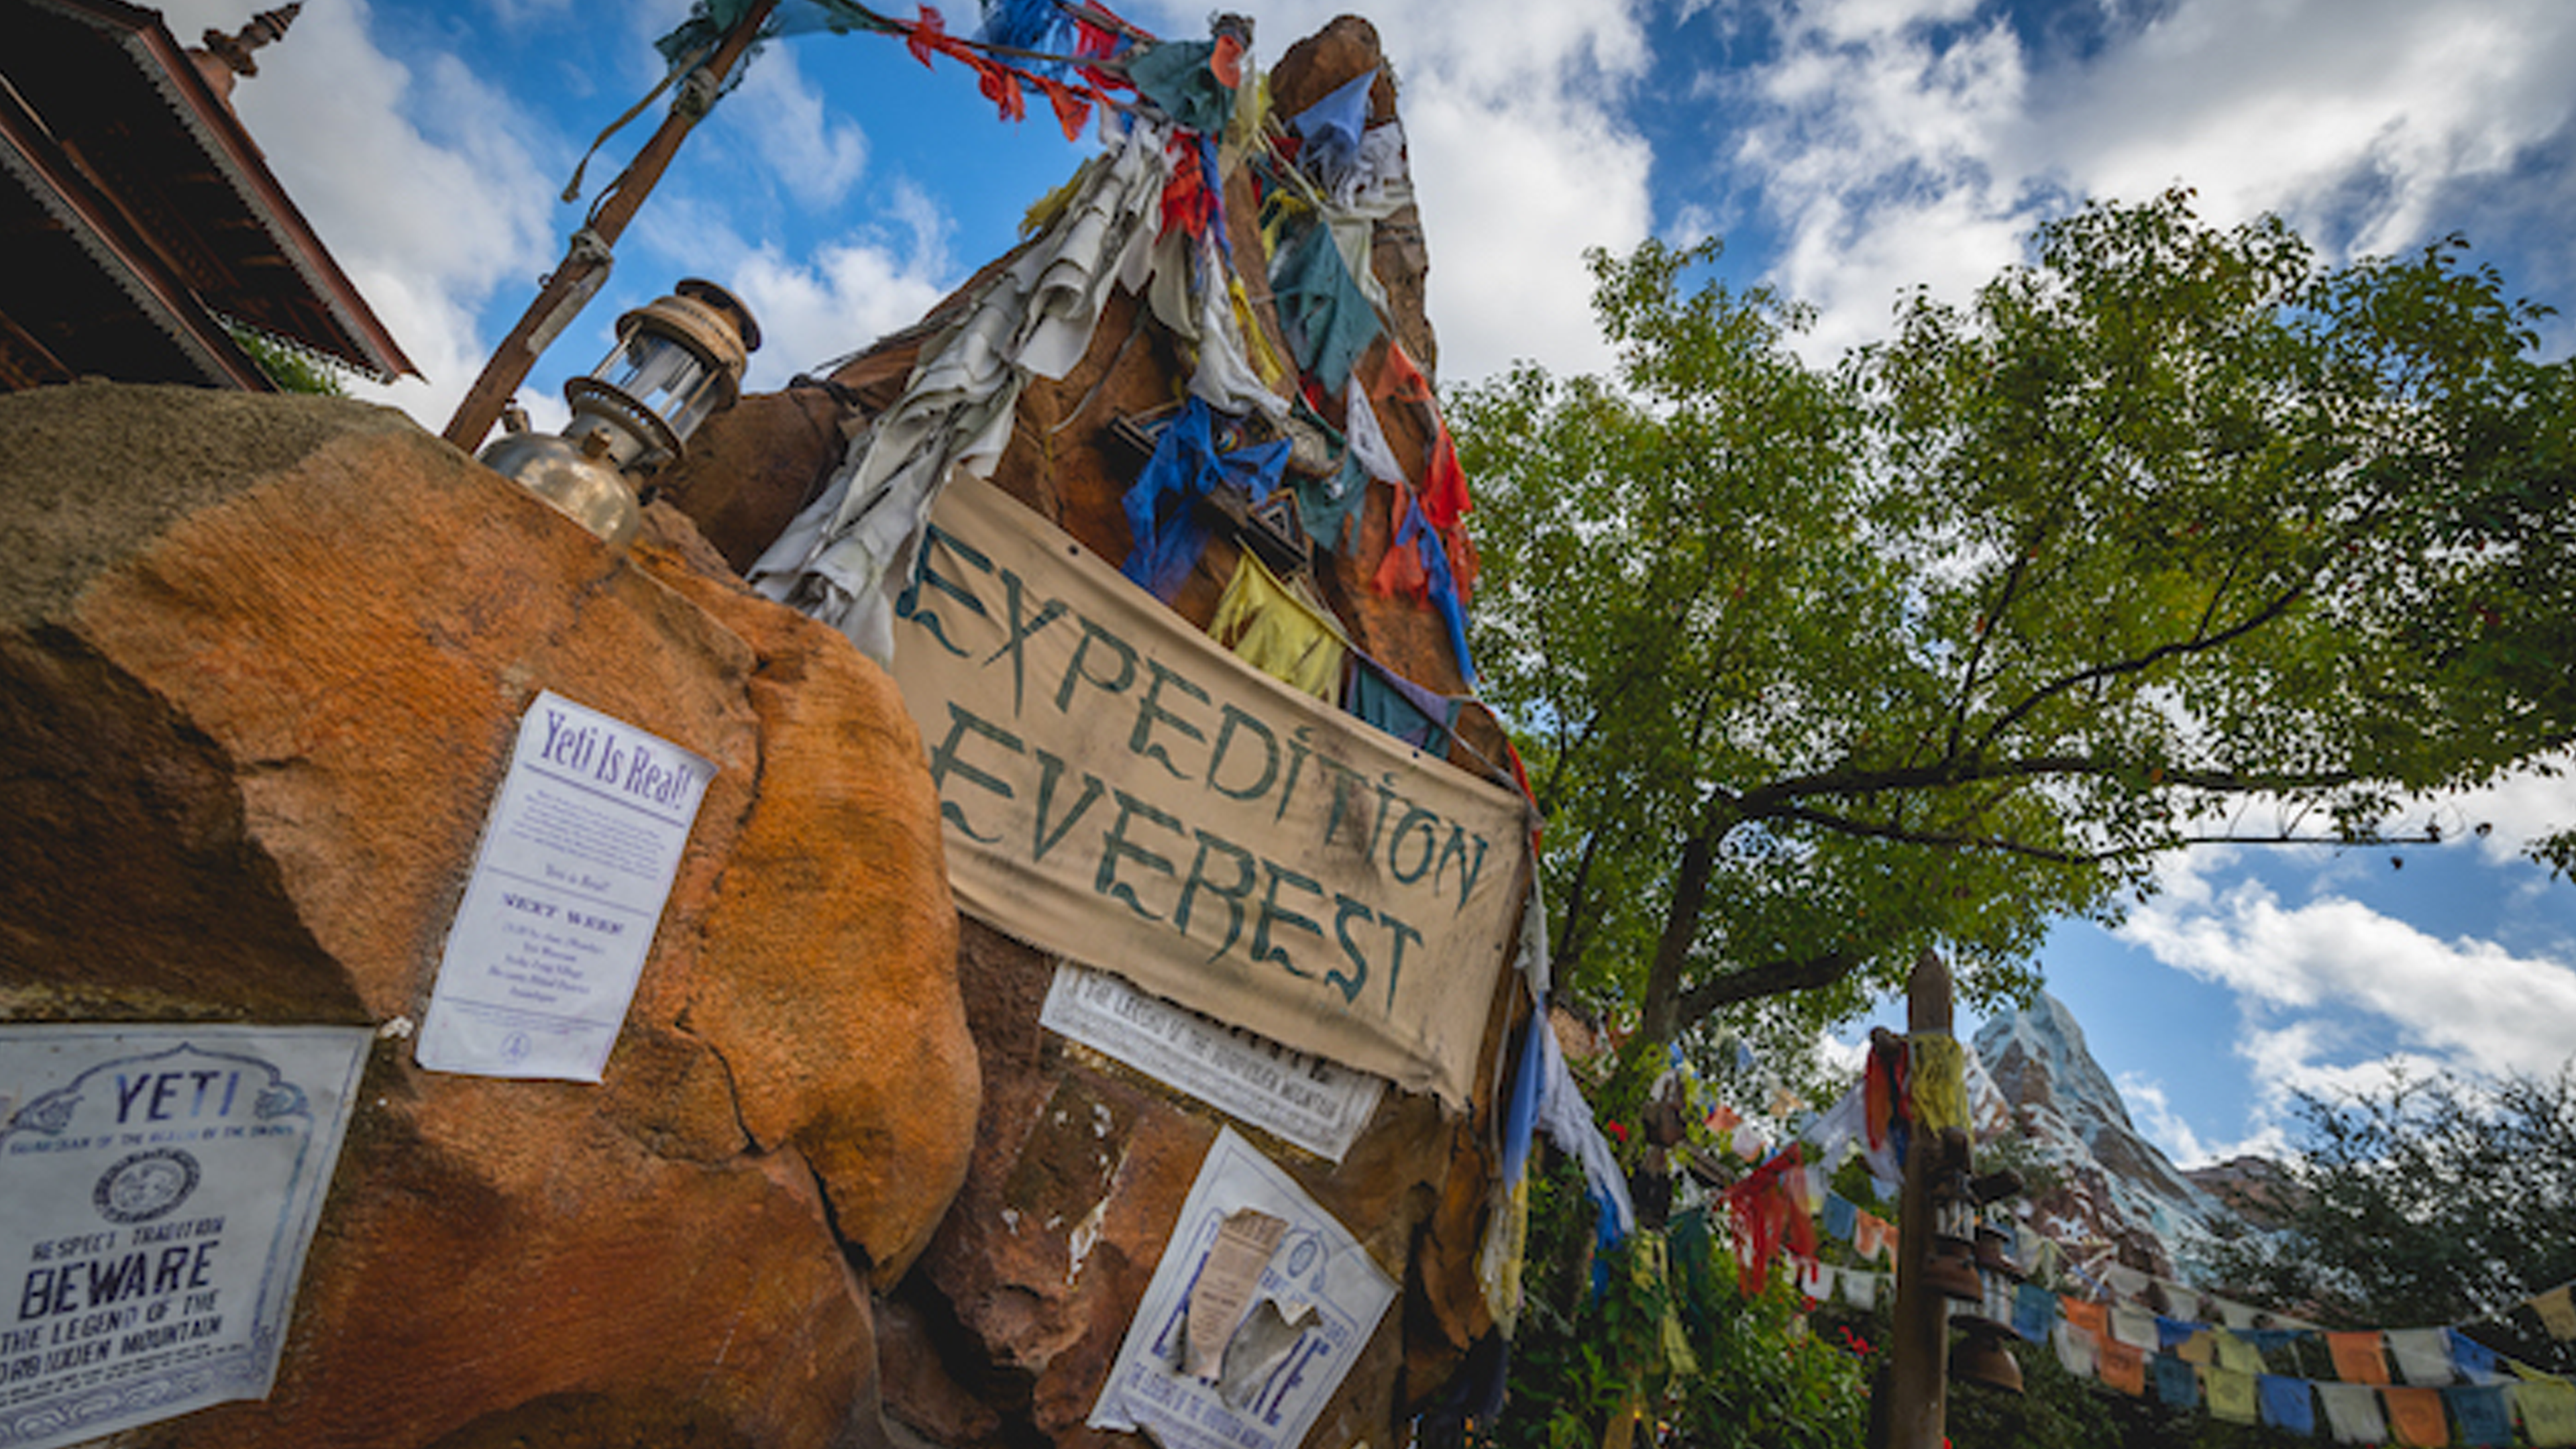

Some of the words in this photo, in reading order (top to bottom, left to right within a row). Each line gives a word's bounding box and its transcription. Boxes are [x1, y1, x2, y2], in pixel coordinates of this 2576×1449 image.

[541, 708, 598, 772] Yeti
[595, 735, 625, 784] Is
[623, 745, 694, 810] Real!
[930, 700, 1424, 1021] EVEREST
[115, 1071, 241, 1123] YETI
[32, 1231, 117, 1263] RESPECT
[132, 1216, 225, 1246] TRADITION
[19, 1240, 221, 1322] BEWARE
[0, 1324, 44, 1355] THE
[51, 1307, 138, 1345] LEGEND
[146, 1299, 171, 1324] OF
[182, 1289, 220, 1316] THE
[121, 1316, 222, 1356] MOUNTAIN
